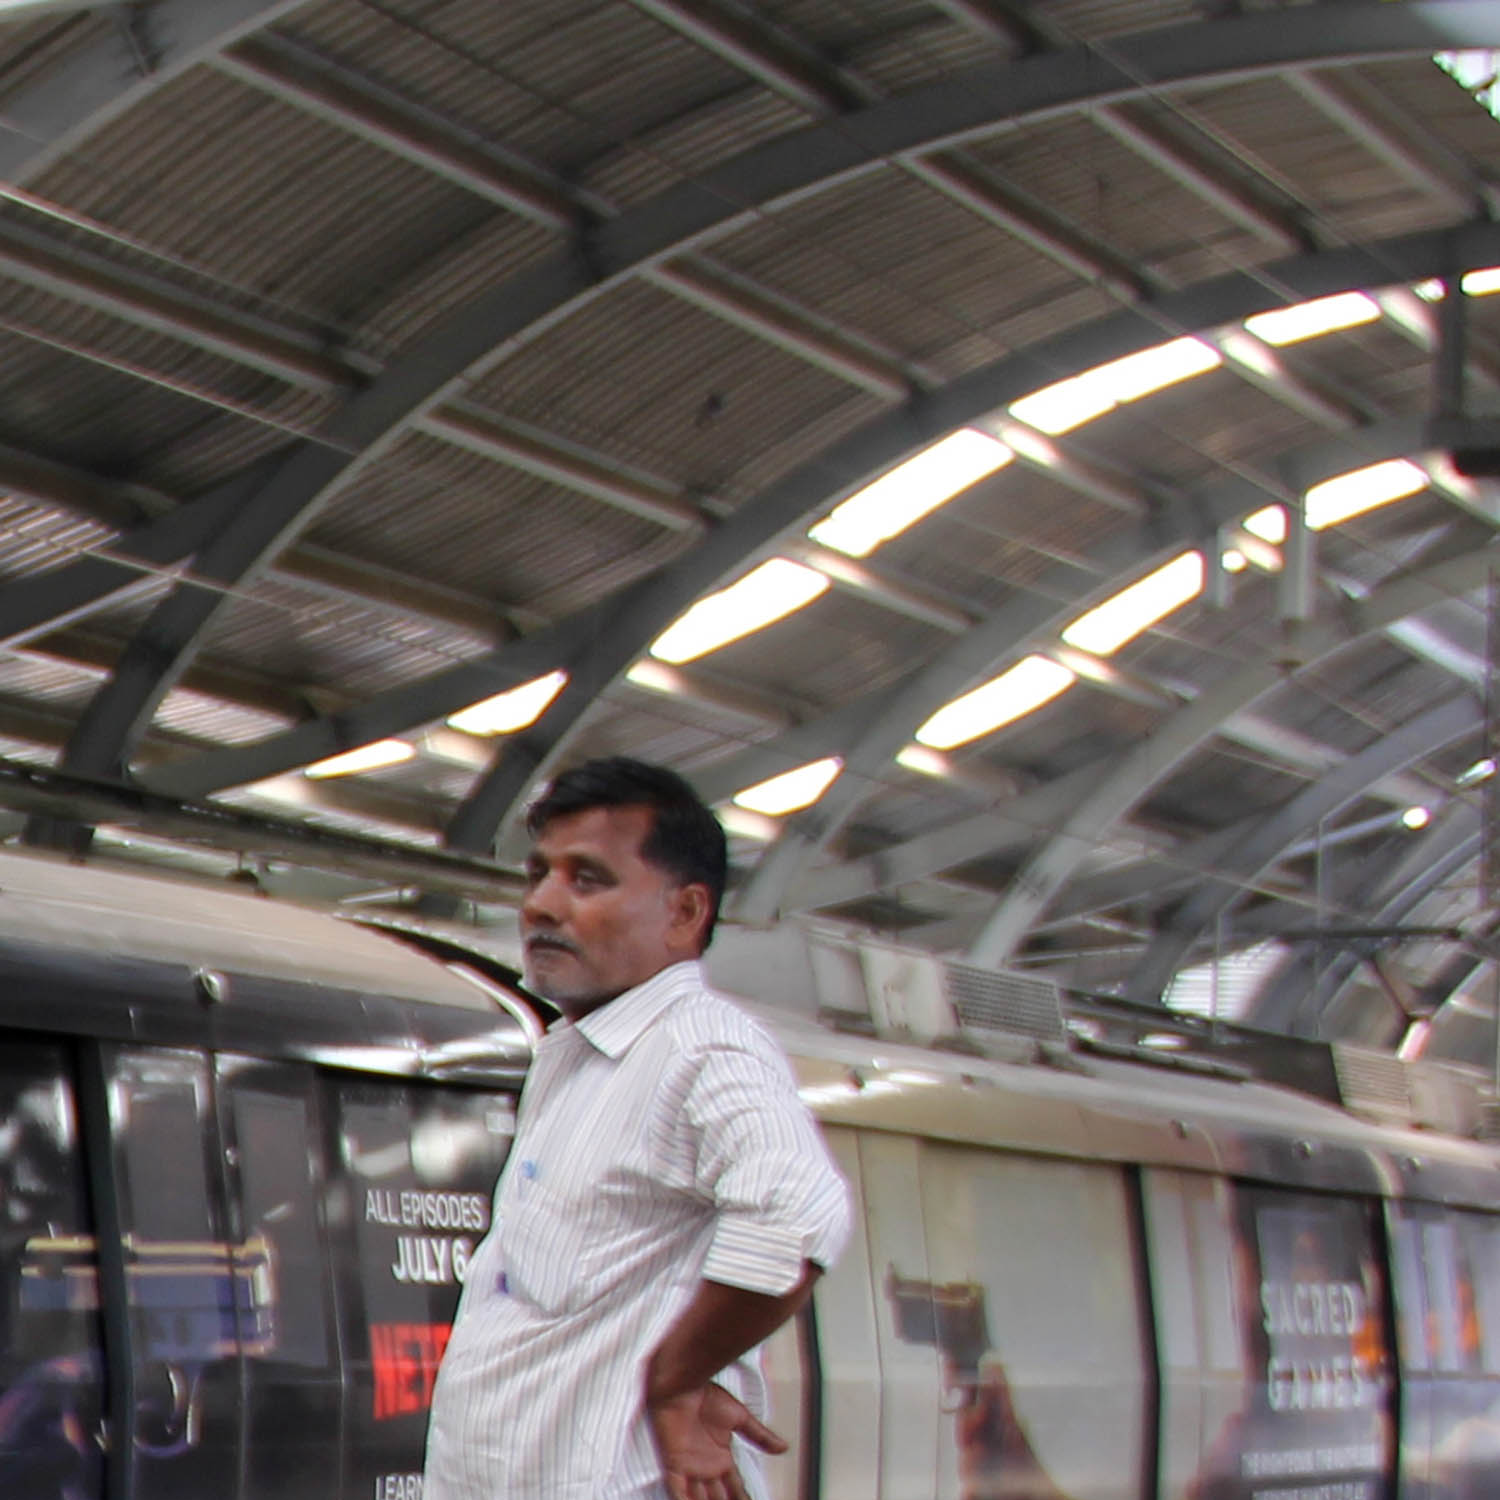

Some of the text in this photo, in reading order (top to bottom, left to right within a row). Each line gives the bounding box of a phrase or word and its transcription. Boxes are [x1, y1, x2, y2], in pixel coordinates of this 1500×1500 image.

[366, 1190, 483, 1230] ALL EPISODES
[392, 1236, 468, 1284] JULY 6
[1261, 1280, 1358, 1336] SACRED
[1267, 1357, 1362, 1411] GAMES
